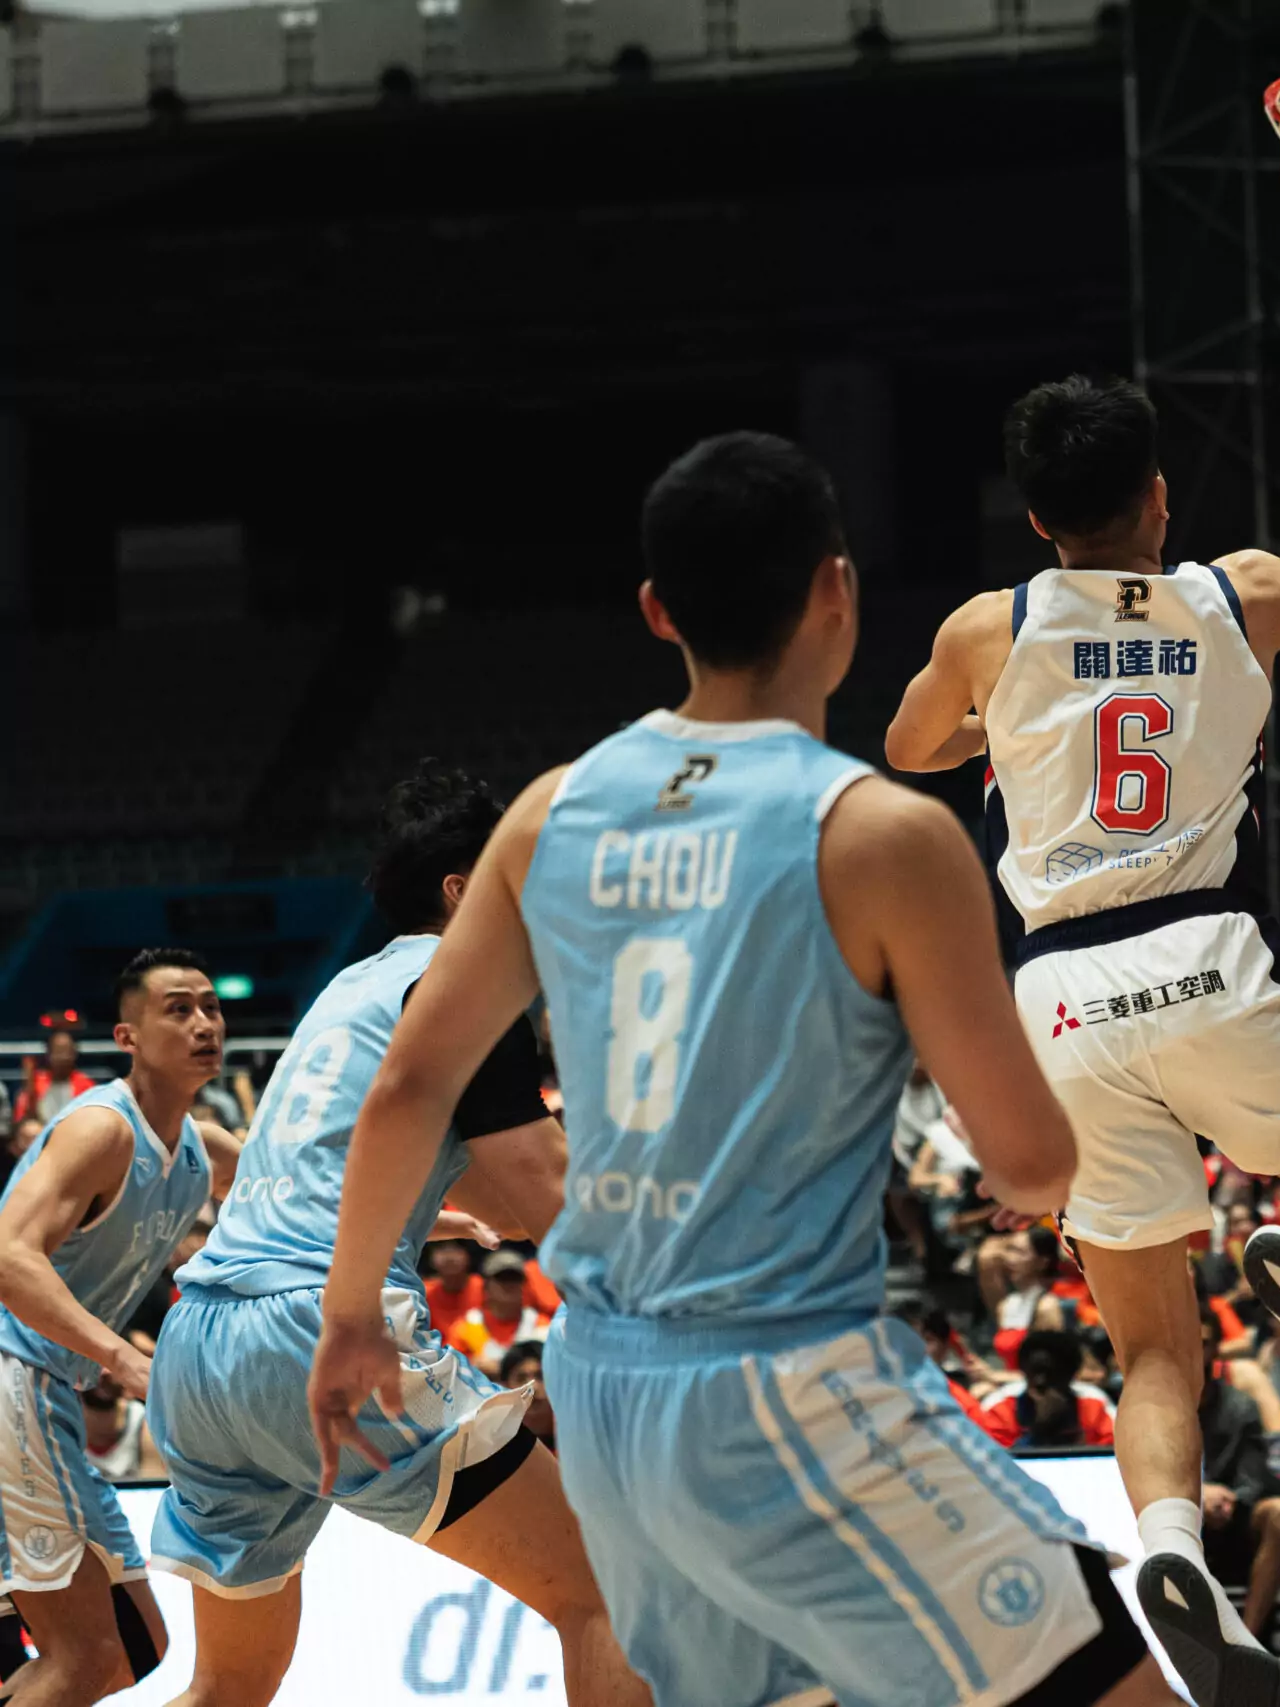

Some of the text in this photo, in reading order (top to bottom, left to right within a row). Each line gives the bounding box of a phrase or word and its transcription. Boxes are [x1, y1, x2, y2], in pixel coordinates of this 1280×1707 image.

[1073, 639, 1197, 679] 關達祐
[1090, 692, 1173, 836] 6
[589, 828, 738, 911] CHOU
[1109, 855, 1158, 870] SLEEP
[1083, 969, 1226, 1025] 三菱重工空調
[607, 936, 693, 1133] 8
